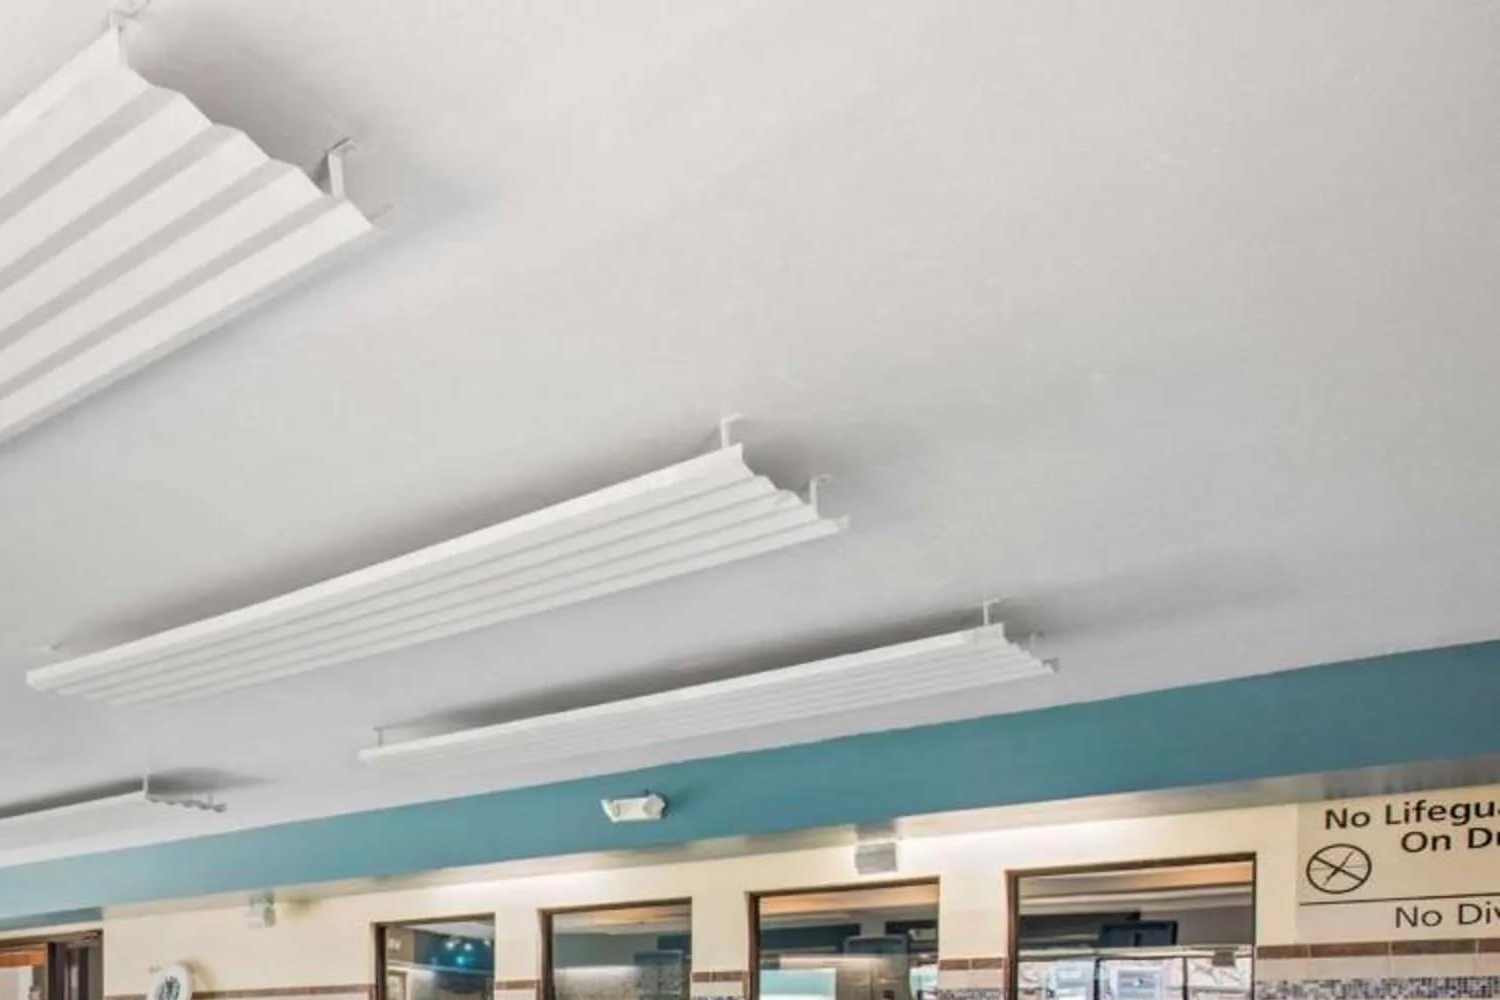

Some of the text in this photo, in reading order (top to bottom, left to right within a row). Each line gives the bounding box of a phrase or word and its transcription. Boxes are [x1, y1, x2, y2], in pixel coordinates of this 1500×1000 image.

[1324, 799, 1500, 830] No Lifegu
[1400, 827, 1500, 853] On D
[1394, 905, 1443, 928] No
